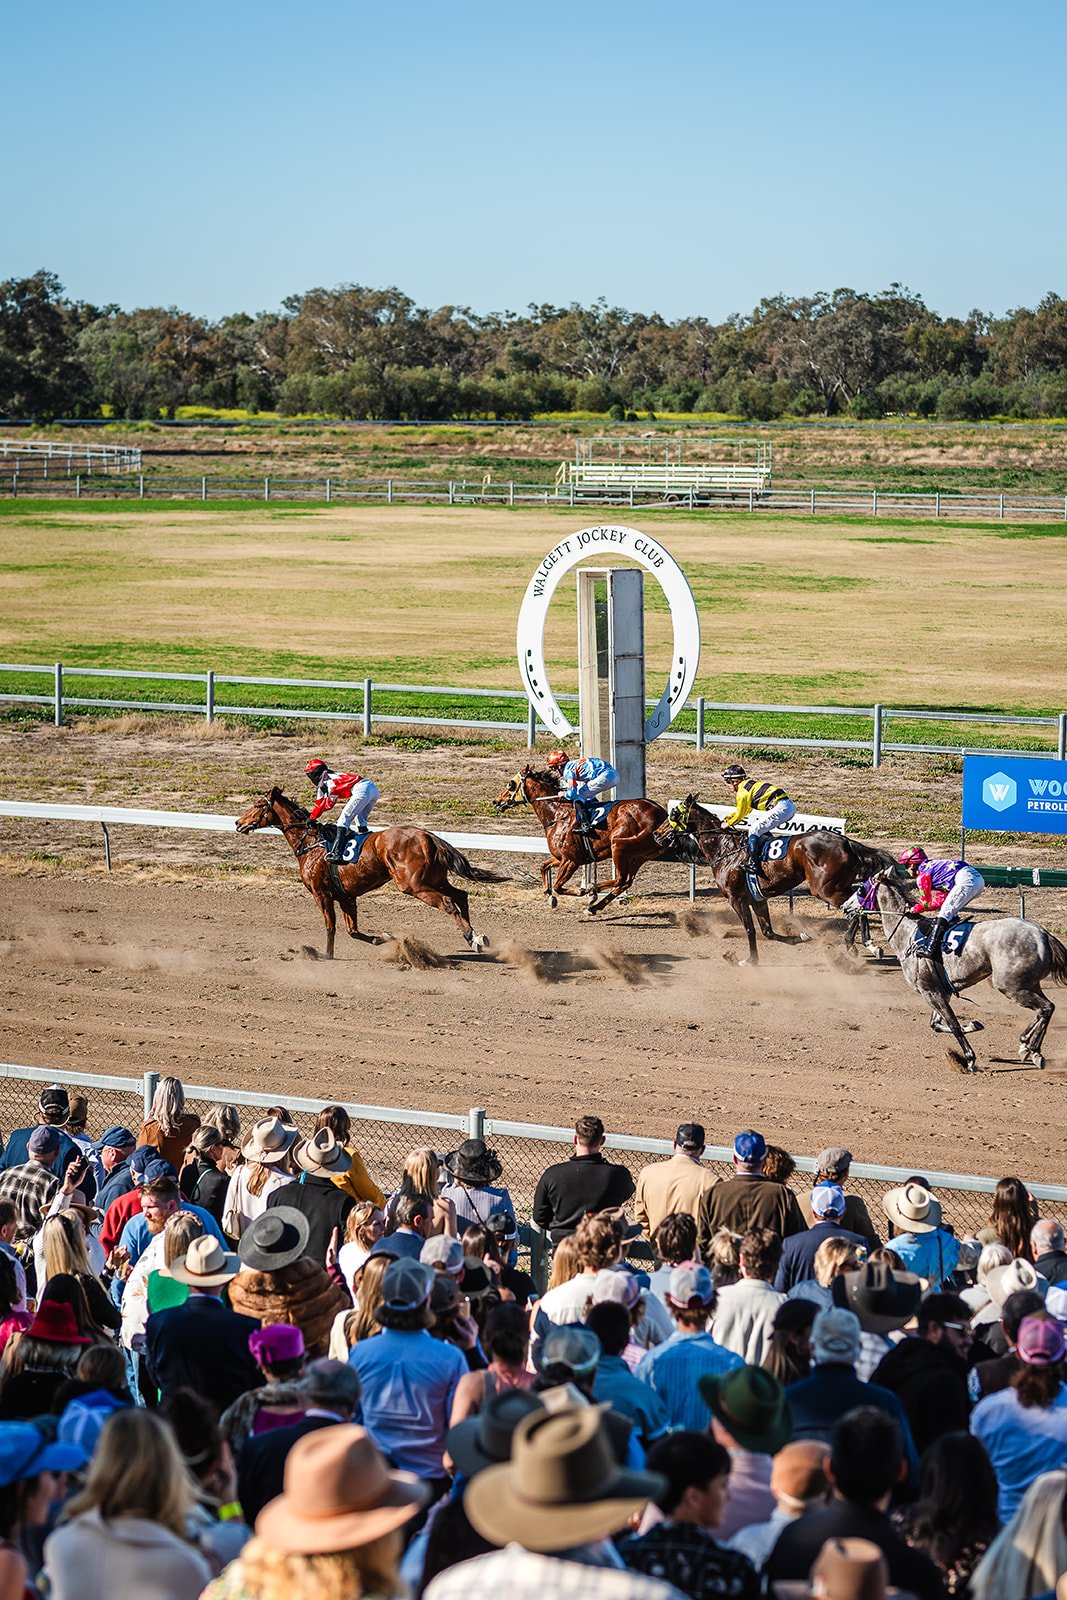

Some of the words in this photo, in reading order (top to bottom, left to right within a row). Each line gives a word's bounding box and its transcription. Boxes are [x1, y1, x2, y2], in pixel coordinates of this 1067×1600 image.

[533, 541, 571, 597] WALGETT
[576, 528, 627, 550] JOCKEY
[634, 538, 664, 568] CLUB
[1028, 779, 1067, 797] WO
[591, 807, 605, 826] 2
[342, 839, 357, 861] 3
[768, 839, 784, 860] 8
[946, 930, 964, 951] 5
